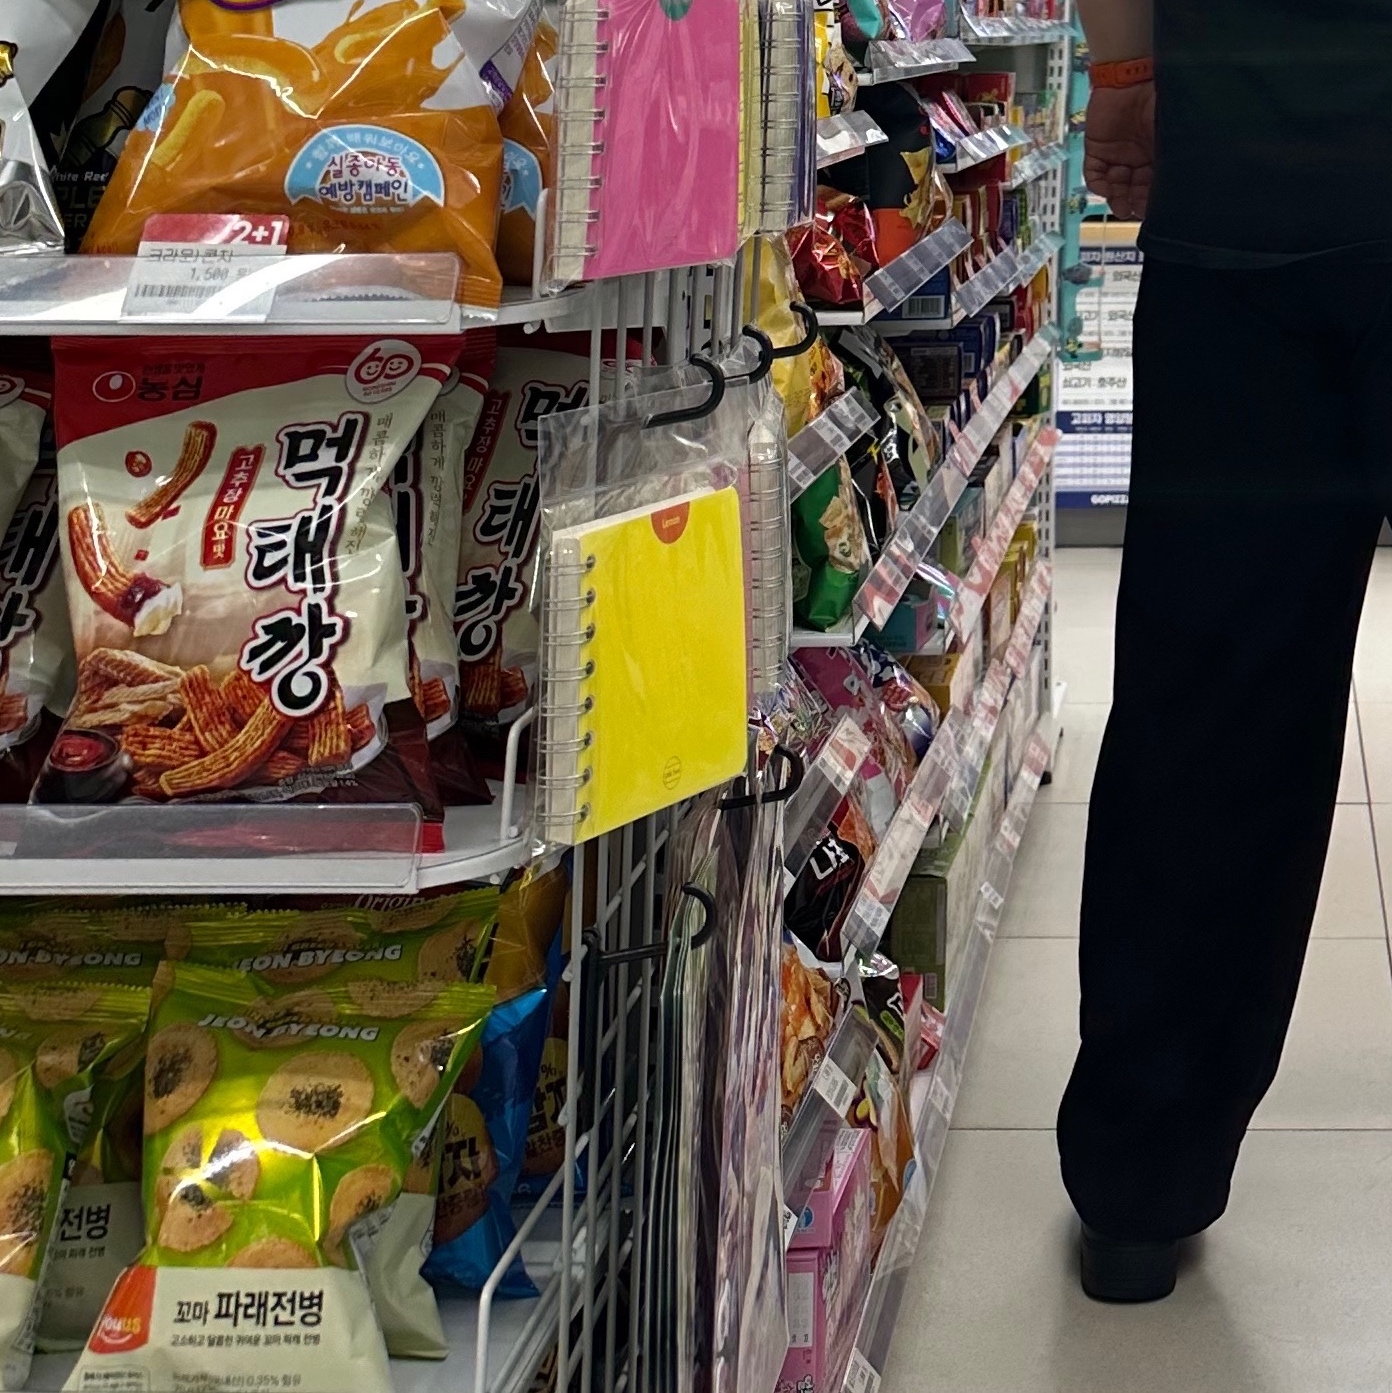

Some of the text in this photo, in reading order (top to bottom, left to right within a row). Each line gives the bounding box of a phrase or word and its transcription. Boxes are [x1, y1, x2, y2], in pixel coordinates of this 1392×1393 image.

[326, 154, 404, 179] 실종아동
[318, 180, 409, 203] 예방캠페인
[232, 218, 283, 245] 2+1
[137, 376, 204, 402] 농심
[240, 411, 370, 717] 먹태깡
[58, 1203, 110, 1242] 전병
[173, 1289, 324, 1329] 꼬마 파래전병
